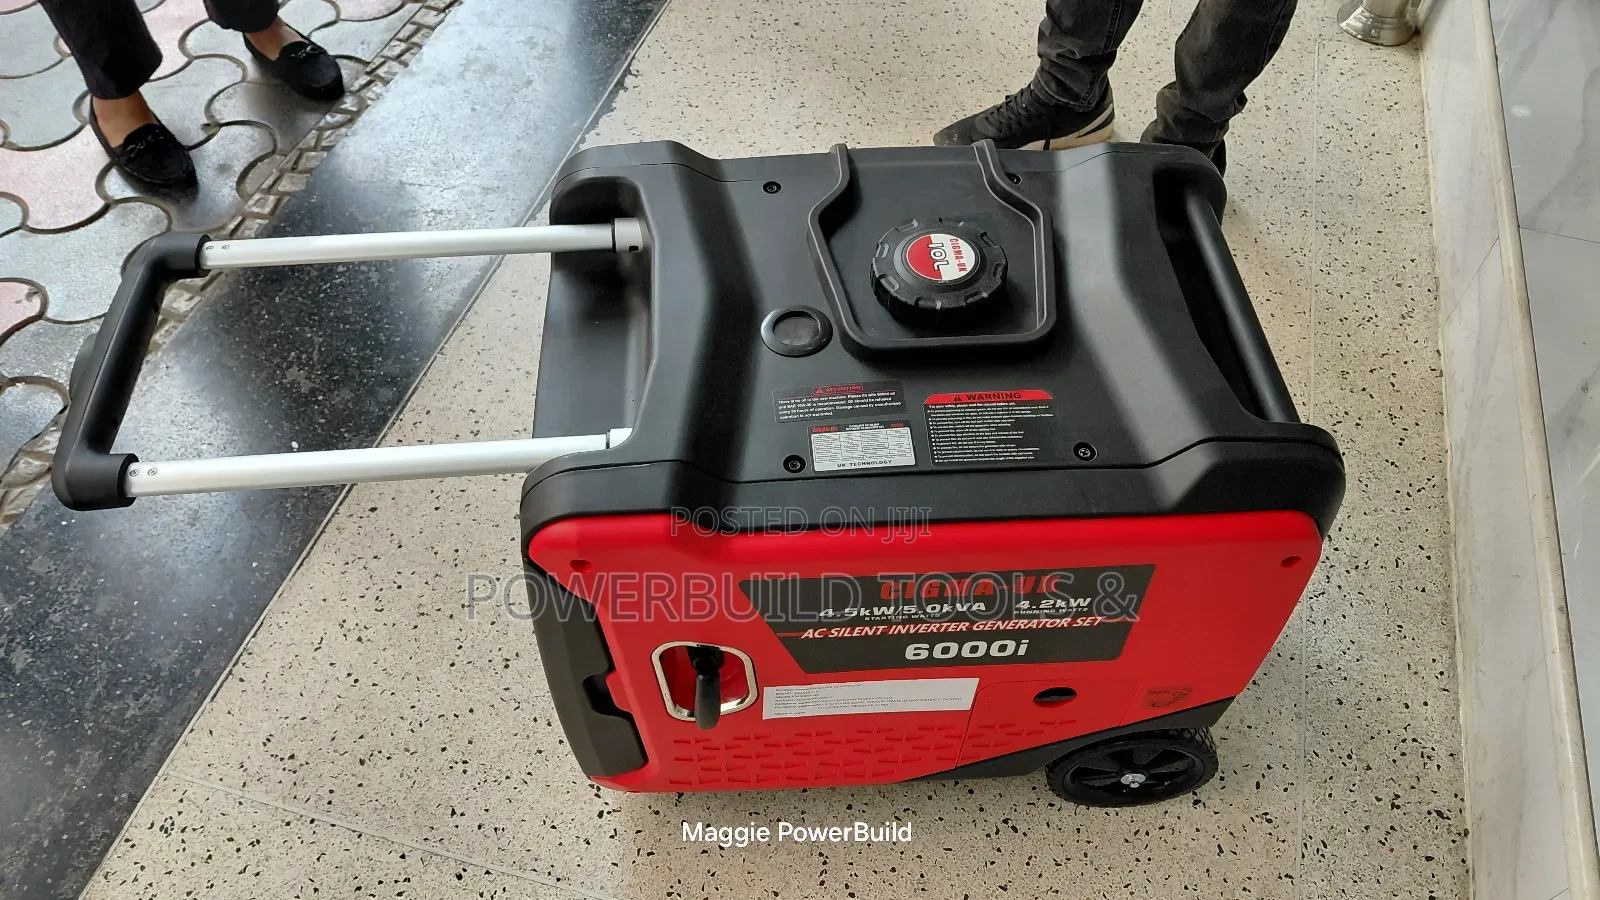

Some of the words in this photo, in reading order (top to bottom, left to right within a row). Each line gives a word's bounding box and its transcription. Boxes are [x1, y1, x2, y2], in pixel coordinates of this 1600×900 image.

[949, 238, 968, 272] CIGMA-UK
[966, 392, 1022, 400] WARNING
[880, 575, 1062, 600] CIGMA-UK
[819, 602, 986, 618] 4.5kW/5.0kVA
[1014, 597, 1092, 610] 4.2kW
[801, 628, 829, 640] AC
[829, 626, 887, 638] SILENT
[888, 622, 970, 636] INVERTER
[972, 618, 1070, 632] GENERATOR
[1072, 616, 1106, 628] SET
[904, 639, 1030, 660] 6000i
